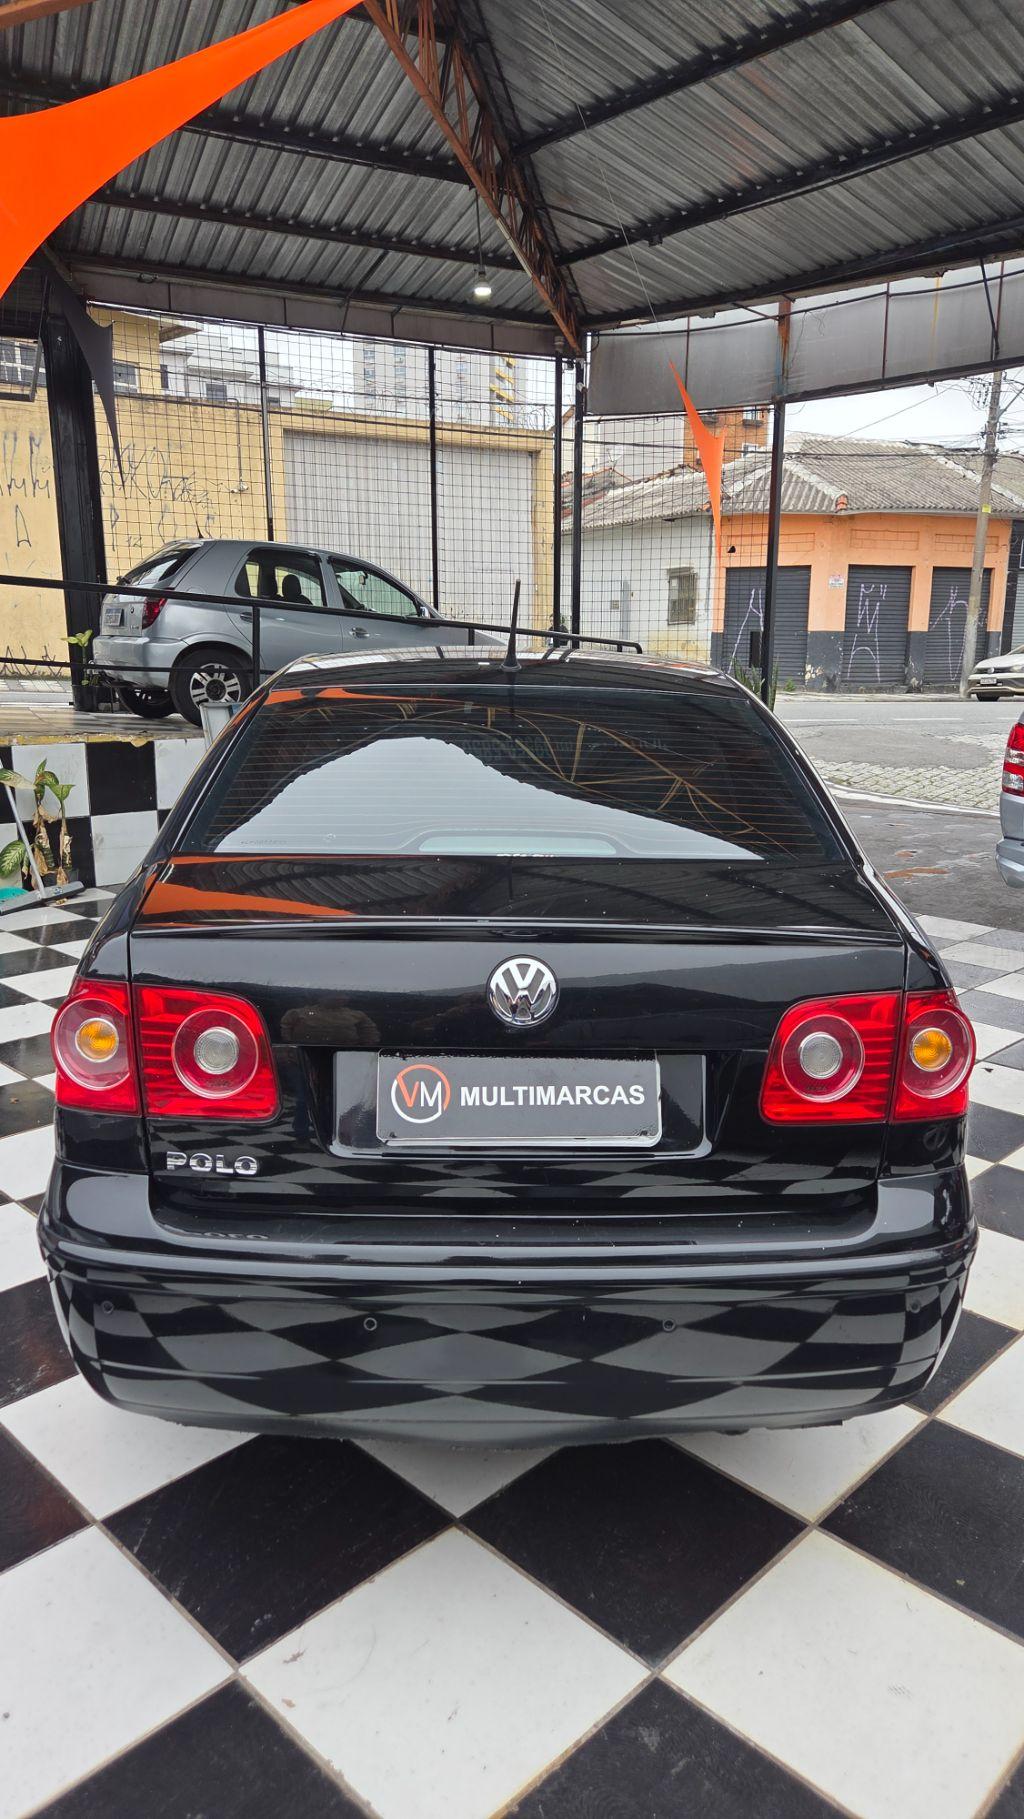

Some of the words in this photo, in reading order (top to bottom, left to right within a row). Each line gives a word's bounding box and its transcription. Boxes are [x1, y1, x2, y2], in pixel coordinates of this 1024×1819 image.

[490, 957, 557, 1025] VW
[396, 1072, 444, 1114] VM
[460, 1085, 645, 1106] MULTIMARCAS
[166, 1151, 258, 1175] POLO
